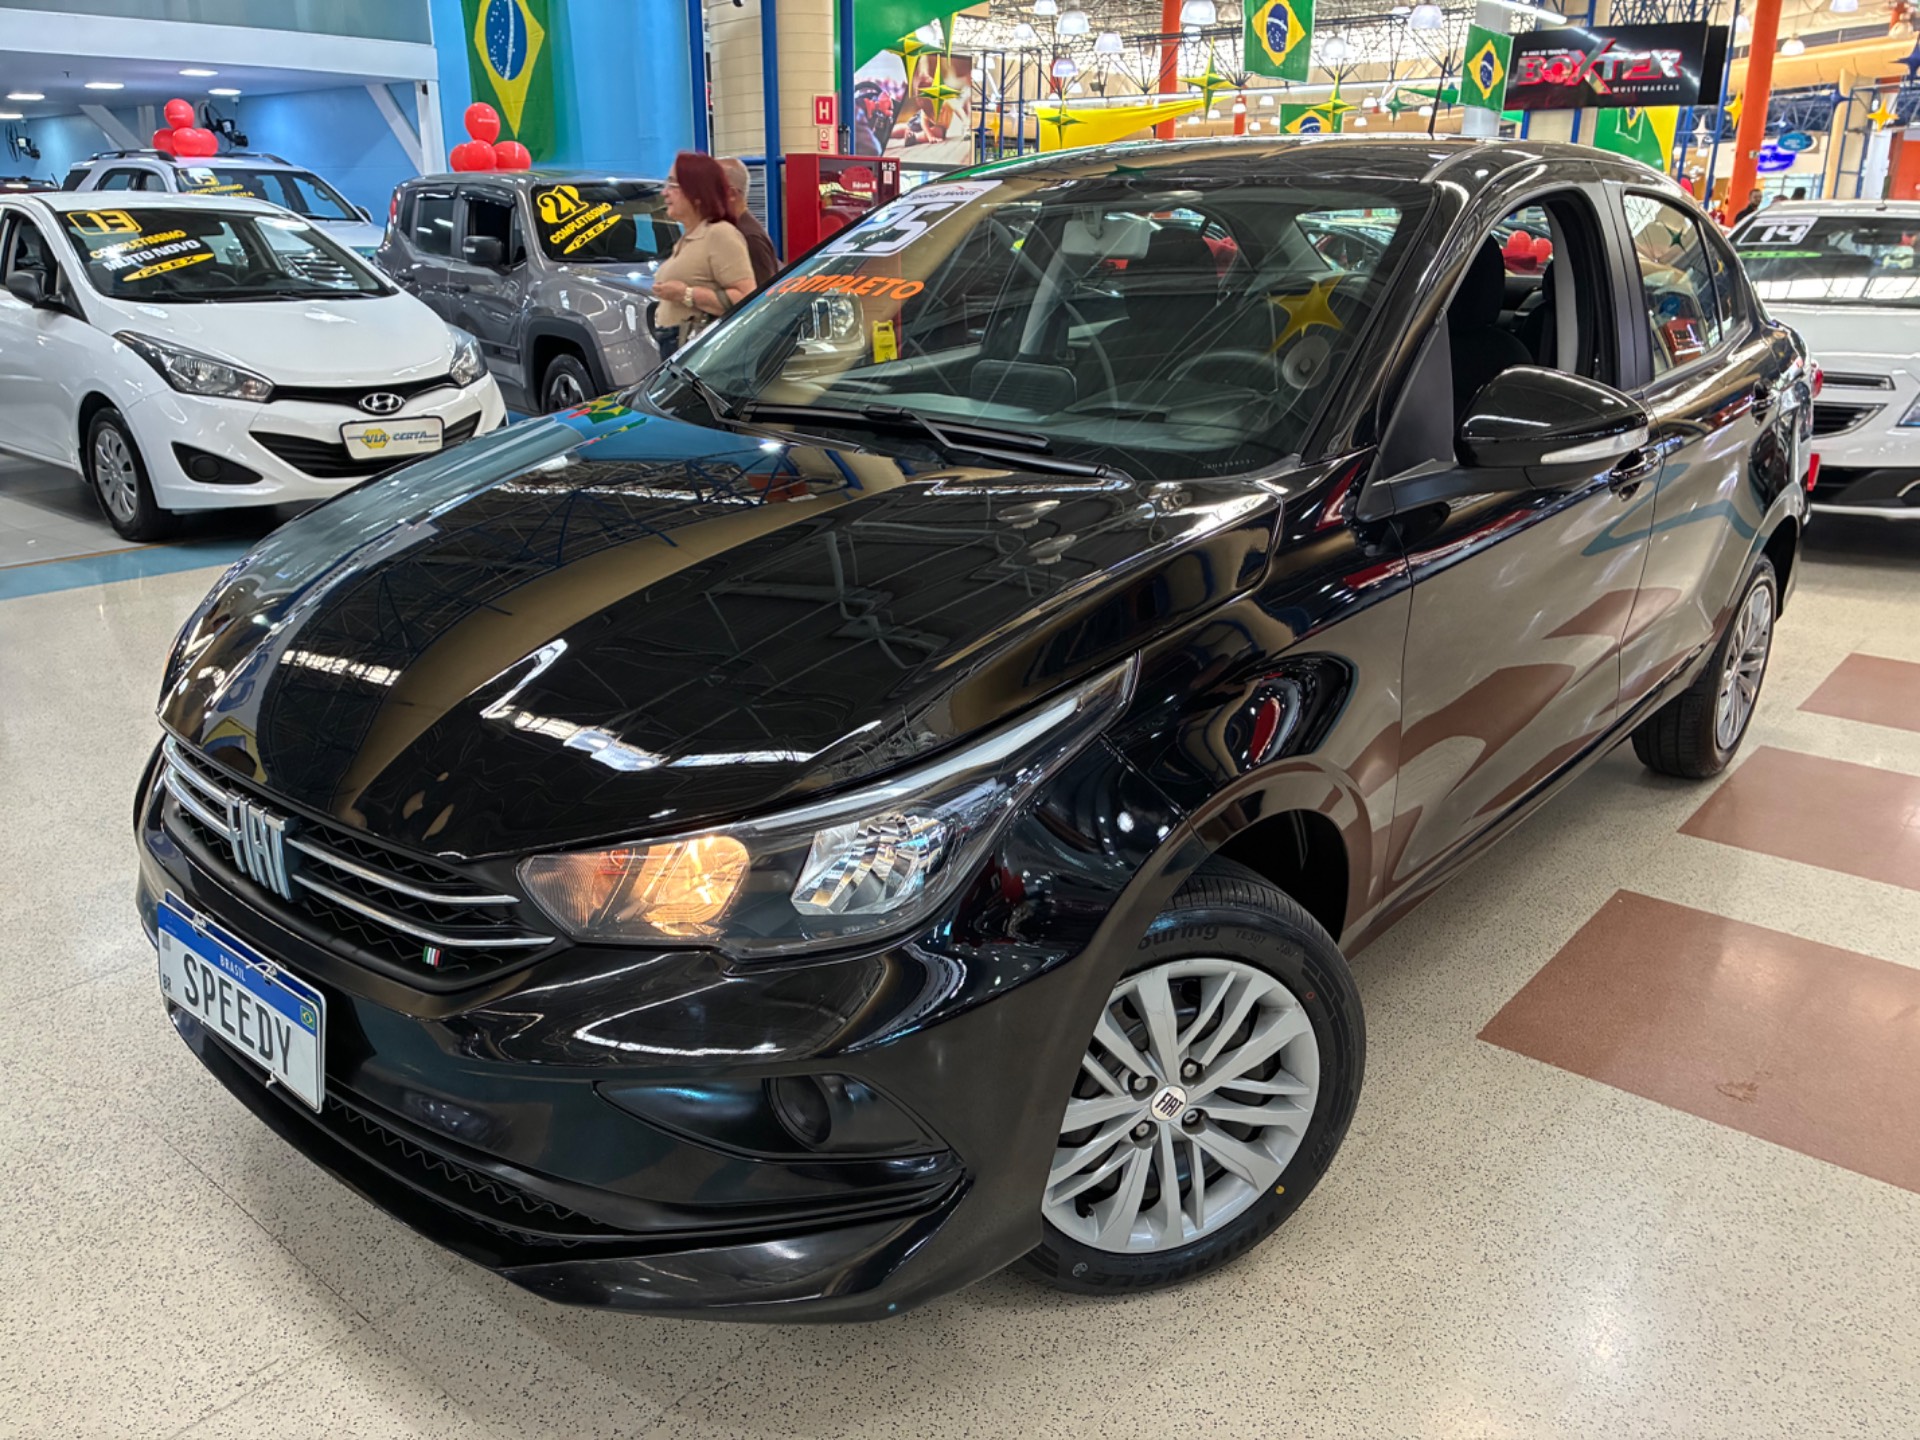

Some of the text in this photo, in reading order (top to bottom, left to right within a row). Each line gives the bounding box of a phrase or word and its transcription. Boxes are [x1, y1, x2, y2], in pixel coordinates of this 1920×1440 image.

[1517, 38, 1683, 94] BOXTER
[1612, 84, 1680, 93] MULTIMARCAS
[819, 101, 830, 120] H
[539, 185, 589, 222] 21
[86, 212, 139, 233] 13
[827, 202, 955, 252] 25
[1760, 225, 1808, 243] 14
[154, 239, 202, 258] NOVO
[226, 791, 292, 902] FIAT
[219, 953, 246, 982] BRASIL
[162, 973, 172, 994] BR
[183, 953, 291, 1076] SPEEDY
[1155, 1092, 1184, 1118] FIAT
